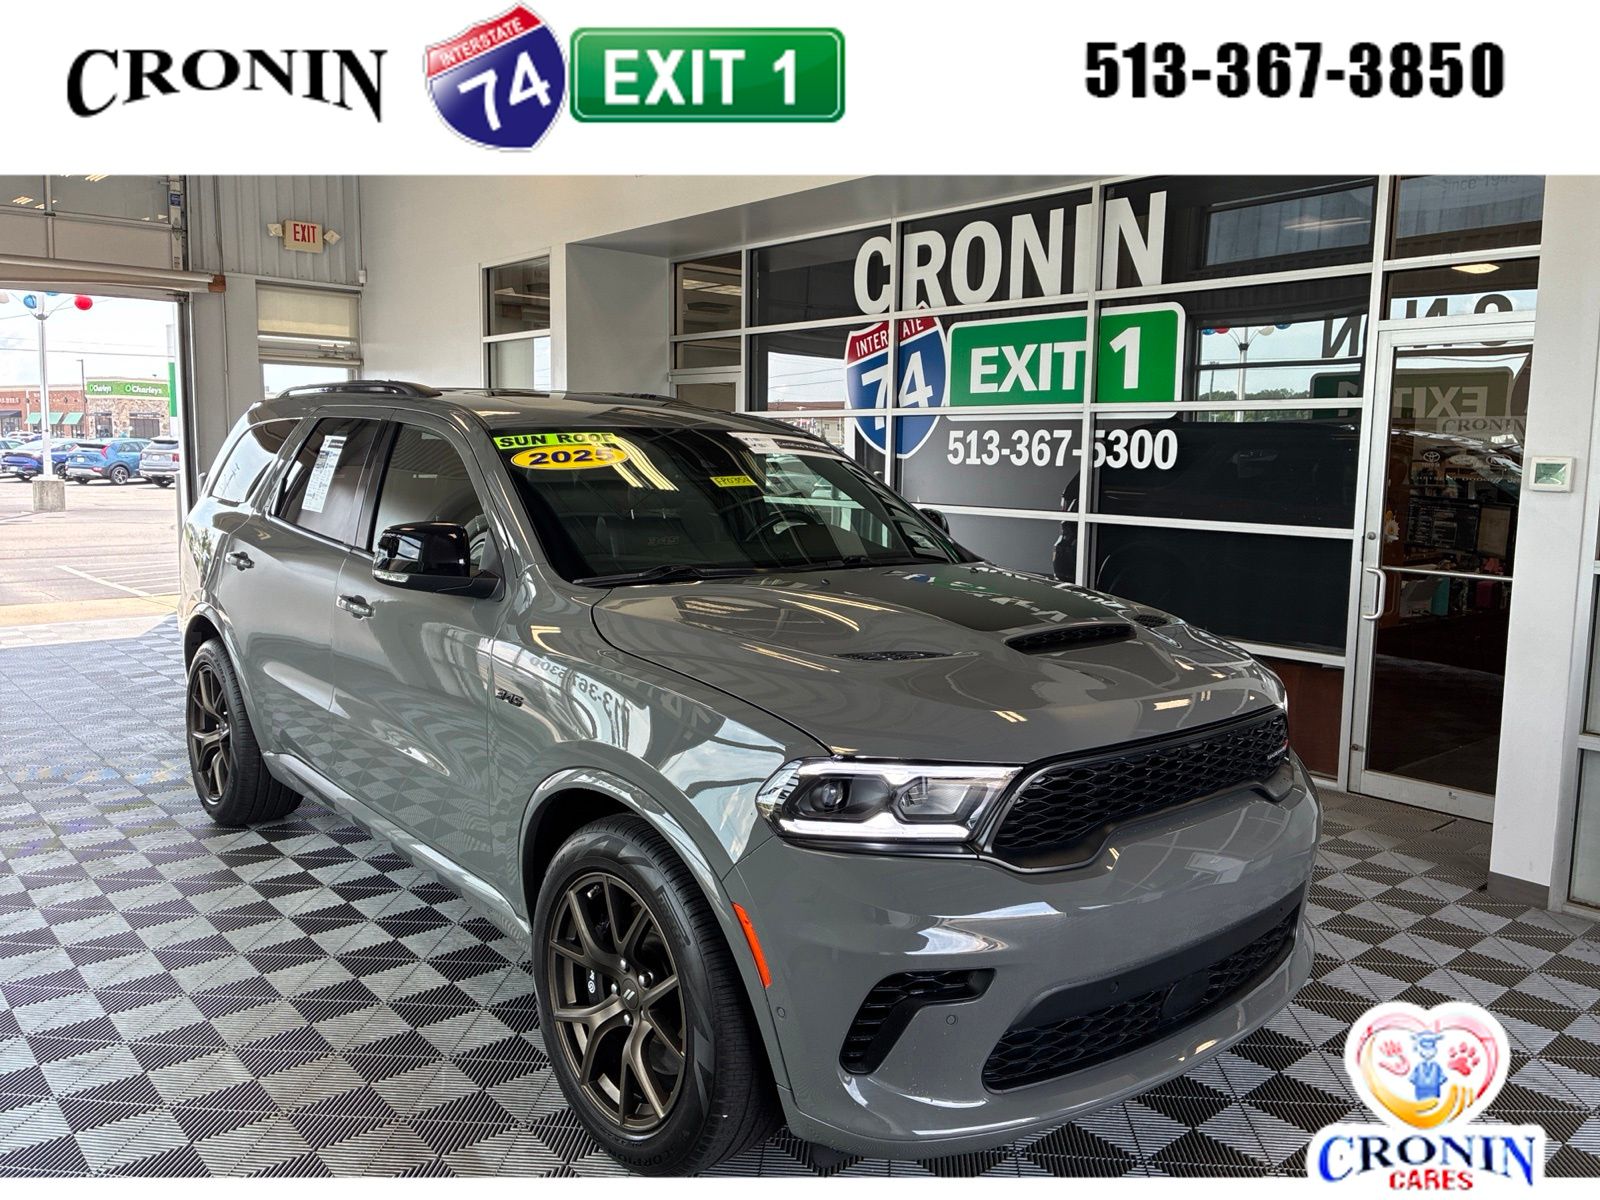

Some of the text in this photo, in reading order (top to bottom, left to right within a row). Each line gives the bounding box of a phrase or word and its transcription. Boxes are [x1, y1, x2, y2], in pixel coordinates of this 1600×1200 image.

[293, 223, 317, 243] EXIT
[854, 191, 1167, 315] CRONIN
[856, 317, 924, 357] INTERATE
[970, 326, 1141, 394] EXIT 1
[861, 351, 934, 430] 74
[500, 435, 546, 448] SUN
[529, 448, 616, 466] 2025
[947, 429, 1178, 470] 513-367-5300
